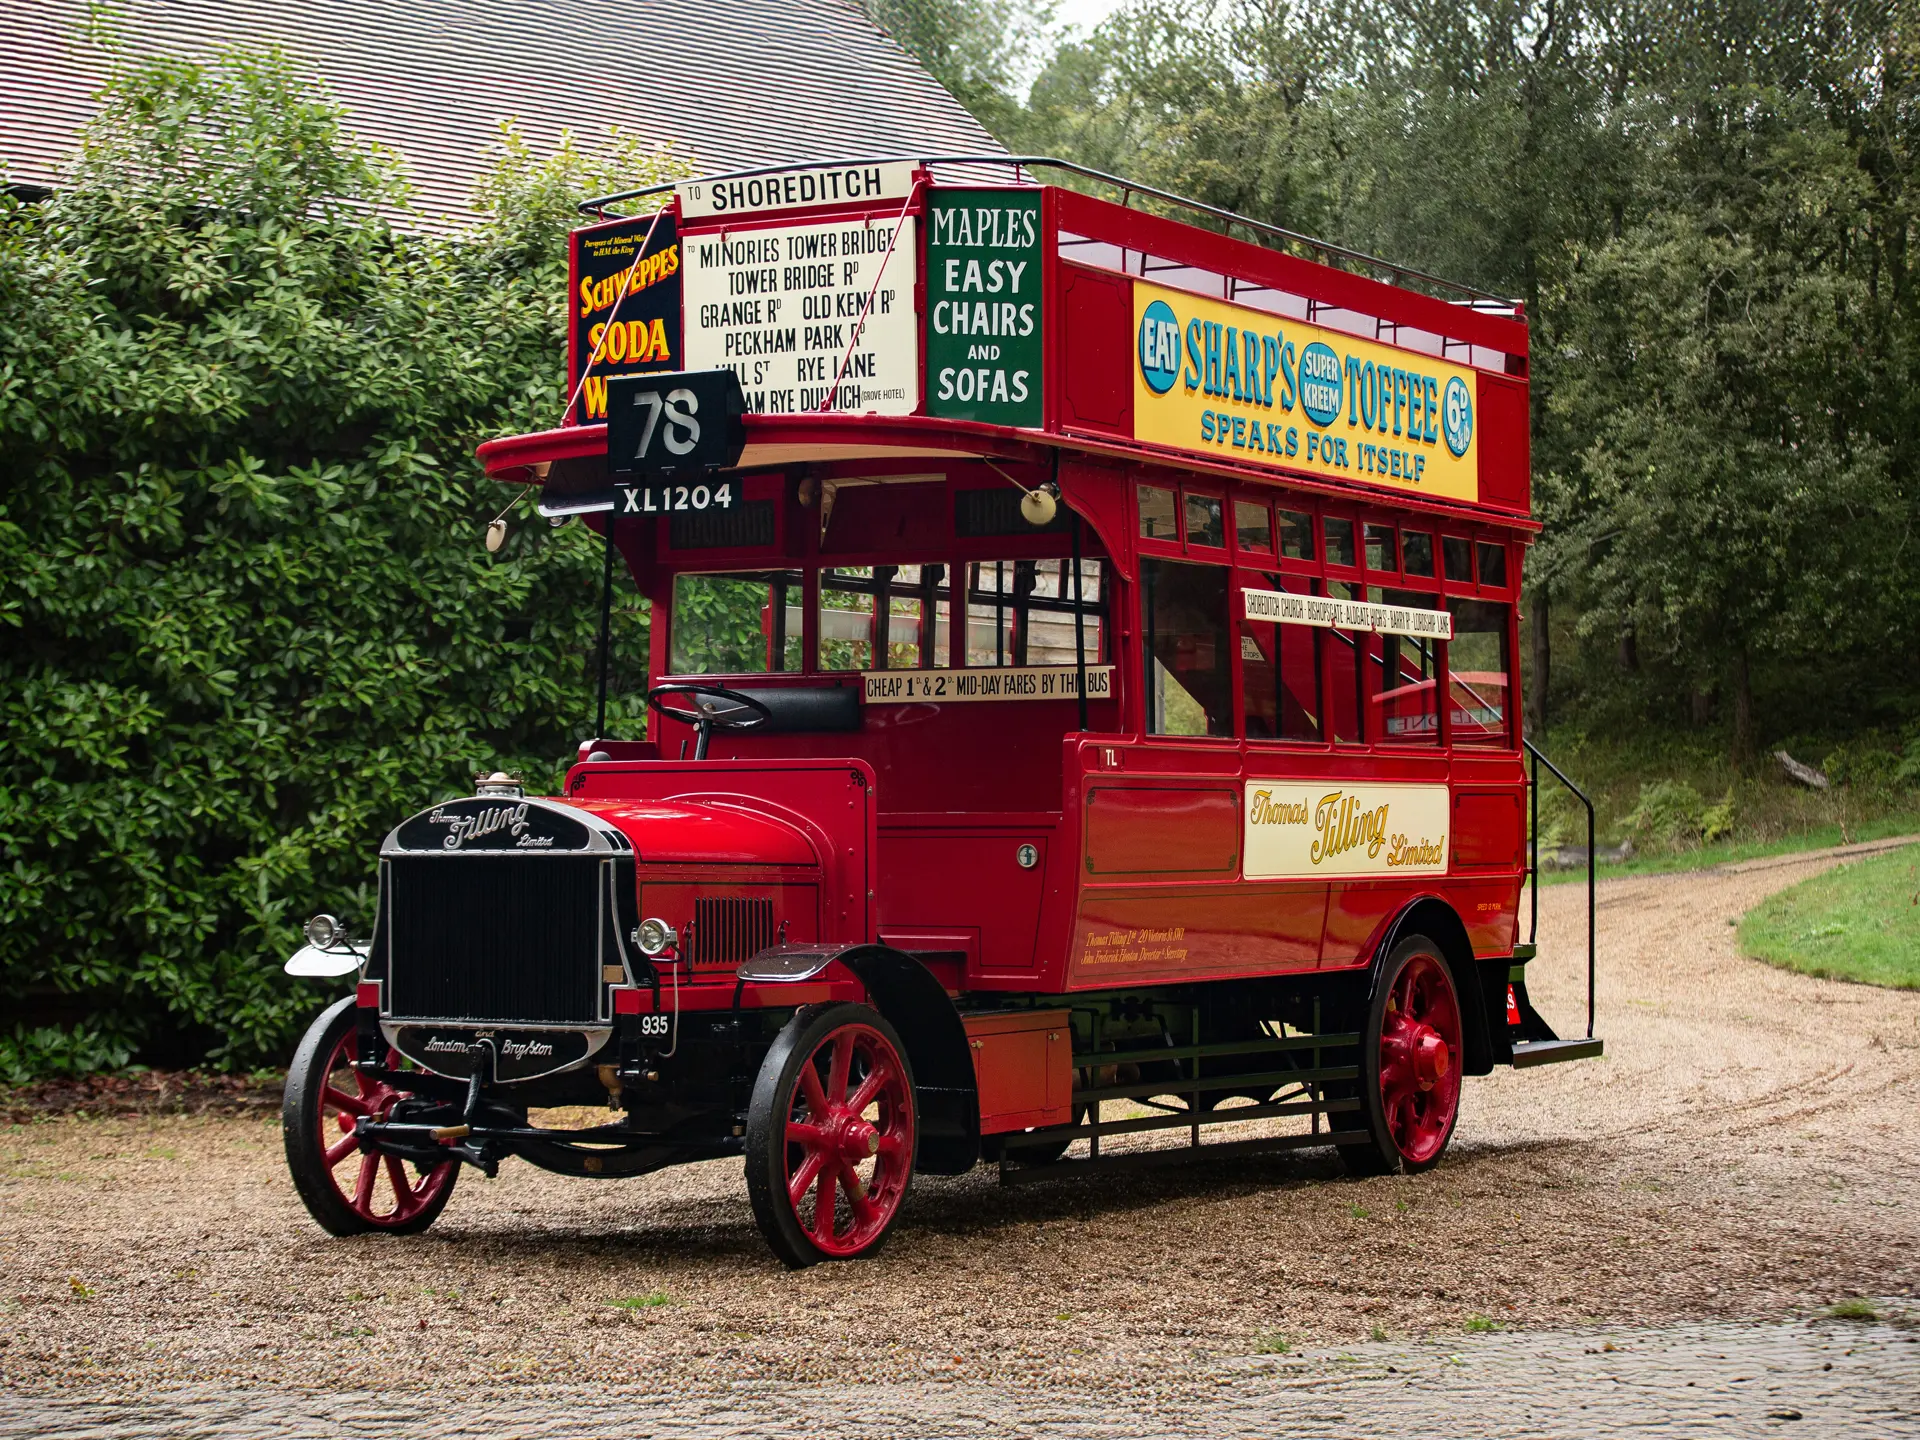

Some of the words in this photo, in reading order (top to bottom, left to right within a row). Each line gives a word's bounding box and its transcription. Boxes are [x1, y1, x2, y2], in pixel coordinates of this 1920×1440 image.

[687, 186, 701, 201] TO
[712, 168, 882, 211] SHOREDITCH
[931, 207, 1037, 248] MAPLES
[620, 246, 635, 256] King
[687, 245, 696, 254] TO
[700, 237, 780, 269] MINORIES
[787, 232, 838, 261] TOWER
[842, 227, 896, 256] BRIDGE
[580, 244, 680, 319] SCHWEPPES
[728, 268, 778, 296] TOWER
[784, 263, 835, 291] BRIDGE
[945, 259, 1028, 294] EASY
[700, 300, 762, 329] GRANGE
[802, 295, 831, 321] OLD
[836, 290, 877, 318] KENT
[933, 300, 1035, 337] CHAIRS
[588, 318, 671, 366] SODA
[725, 328, 796, 357] PECKHAM
[804, 324, 845, 351] PARK
[967, 345, 1001, 361] AND
[1142, 316, 1179, 374] EAT
[797, 356, 826, 382] RYE
[833, 353, 876, 380] LANE
[1184, 316, 1298, 412] SHARP'S
[1345, 354, 1439, 445] TOFFEE
[1304, 350, 1339, 384] SUPER
[770, 389, 795, 414] RYE
[861, 390, 882, 402] (GROVE
[883, 388, 905, 400] HOTEL)
[937, 367, 1030, 403] SOFAS
[1304, 381, 1340, 415] KREEM
[1200, 409, 1299, 457] SPEAKS
[1306, 431, 1349, 468] FOR
[1357, 442, 1426, 482] ITSELF
[1247, 593, 1280, 617] SHOREDITCH
[1281, 597, 1304, 619] CHURCH
[1307, 600, 1344, 624] BISHOPSGATE
[1346, 605, 1370, 626] ALDGATE
[1413, 612, 1436, 632] LORDSHIP
[1437, 614, 1450, 634] LANE
[867, 676, 902, 697] CHEAP
[923, 677, 932, 696] &
[956, 674, 1001, 696] MID-DAY
[1004, 673, 1036, 695] FARES
[1041, 673, 1056, 694] BY
[1088, 672, 1108, 692] BUS
[1105, 749, 1118, 766] TL
[429, 807, 461, 824] Thomas
[1250, 789, 1309, 825] Thomas
[443, 803, 530, 849] Tilling
[516, 833, 555, 847] Limited
[1310, 790, 1390, 865] Tilling
[1387, 833, 1445, 867] Limited
[1086, 932, 1108, 947] Thomas
[1108, 931, 1127, 947] Tilling
[1138, 928, 1149, 943] 20
[1081, 950, 1095, 965] John
[641, 1016, 669, 1035] 935
[424, 1036, 469, 1053] London
